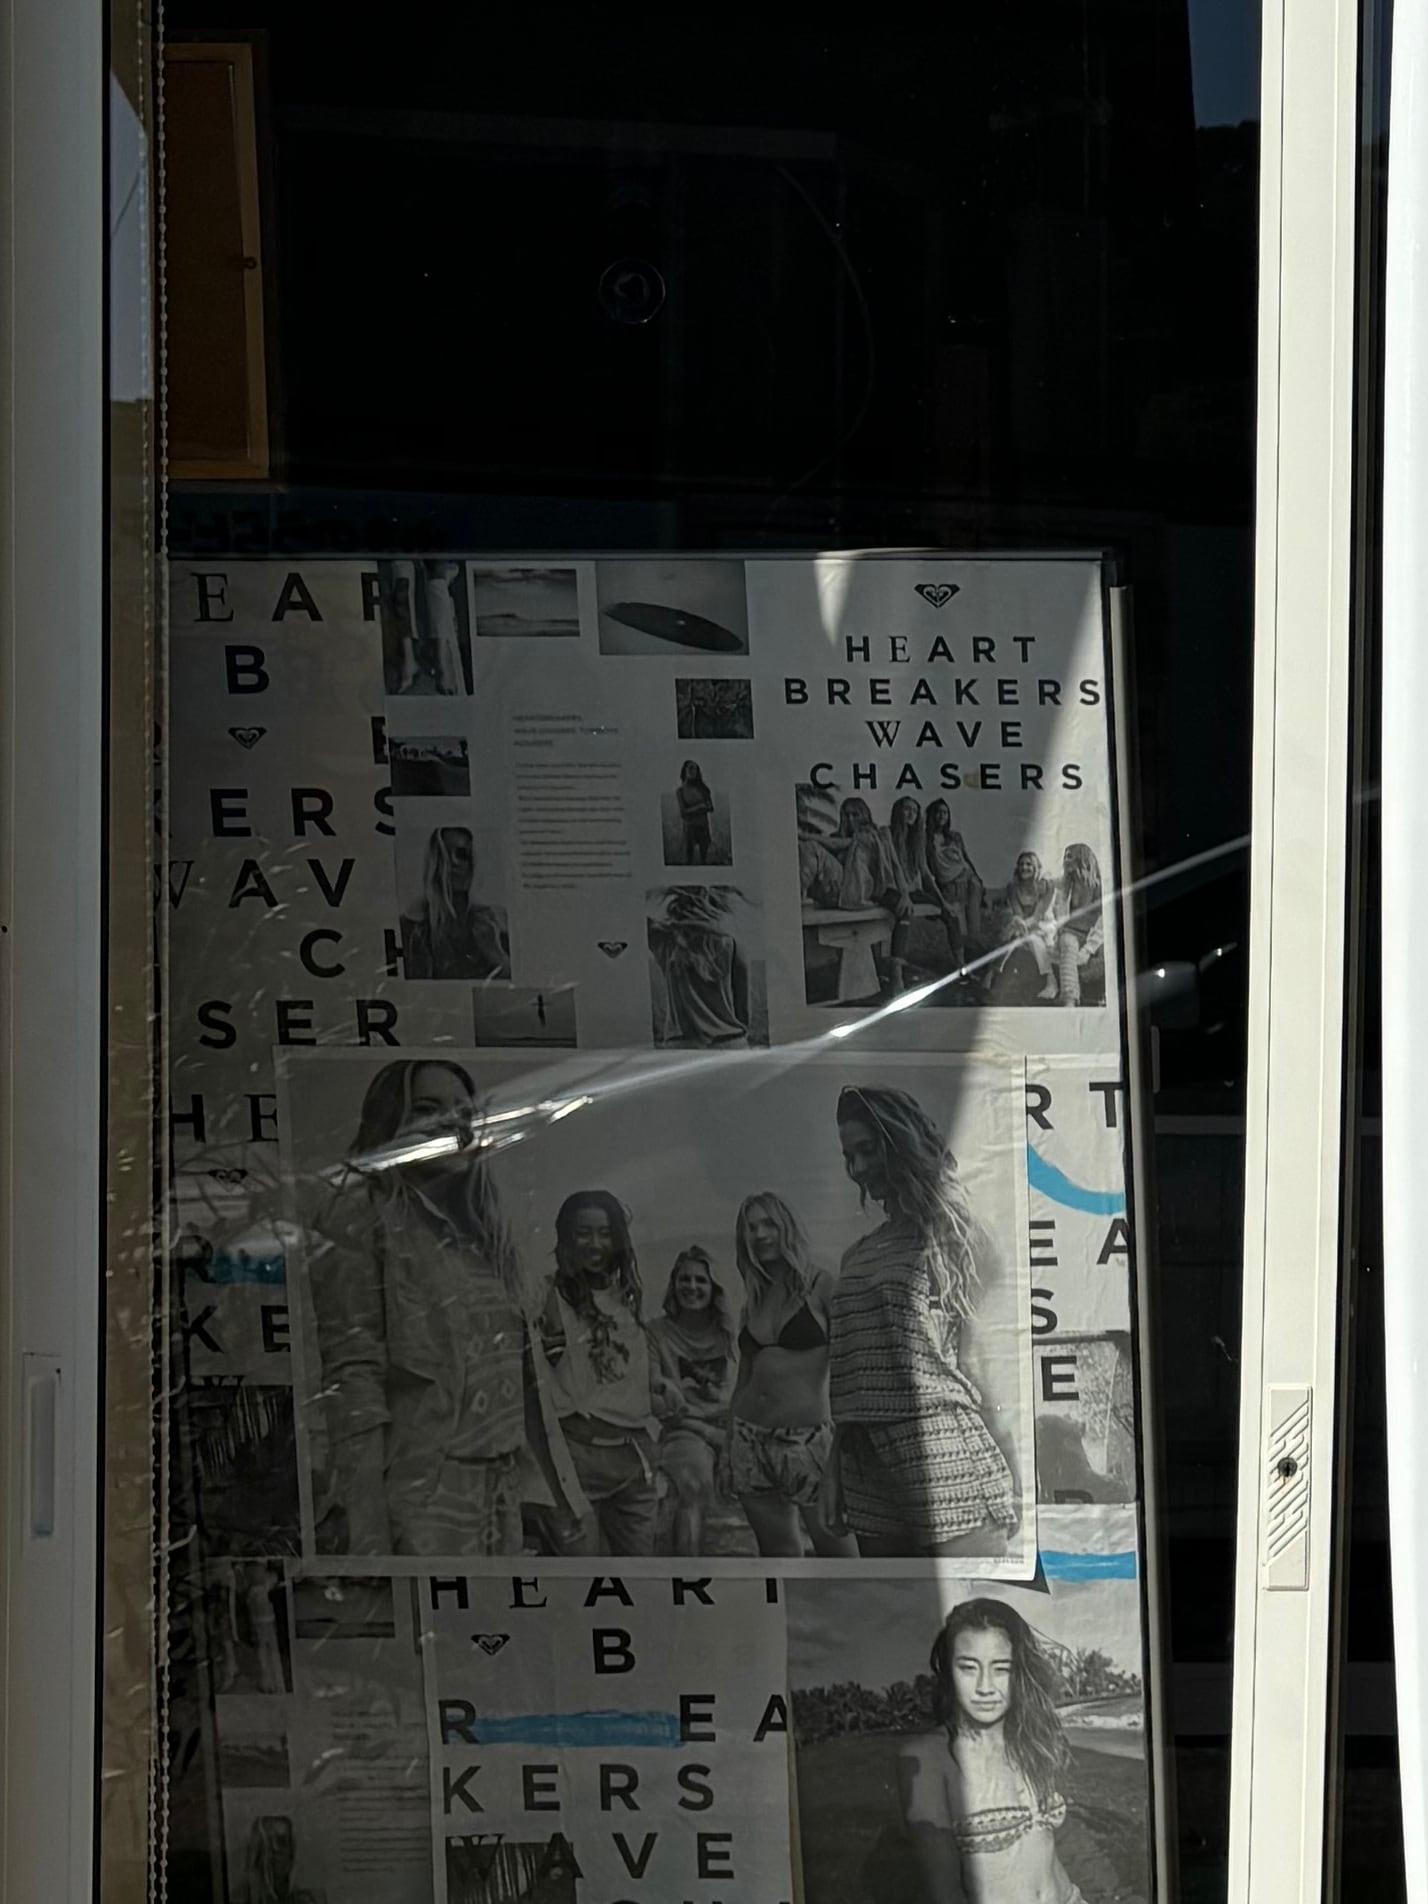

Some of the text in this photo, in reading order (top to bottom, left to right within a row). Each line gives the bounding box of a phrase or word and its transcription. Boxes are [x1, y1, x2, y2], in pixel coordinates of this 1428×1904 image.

[845, 636, 1036, 663] HEART
[784, 678, 1101, 706] BREAKERS
[867, 720, 1023, 748] WAVE
[810, 763, 1084, 791] CHASERS
[592, 1628, 636, 1675] B
[443, 1764, 715, 1815] KERS
